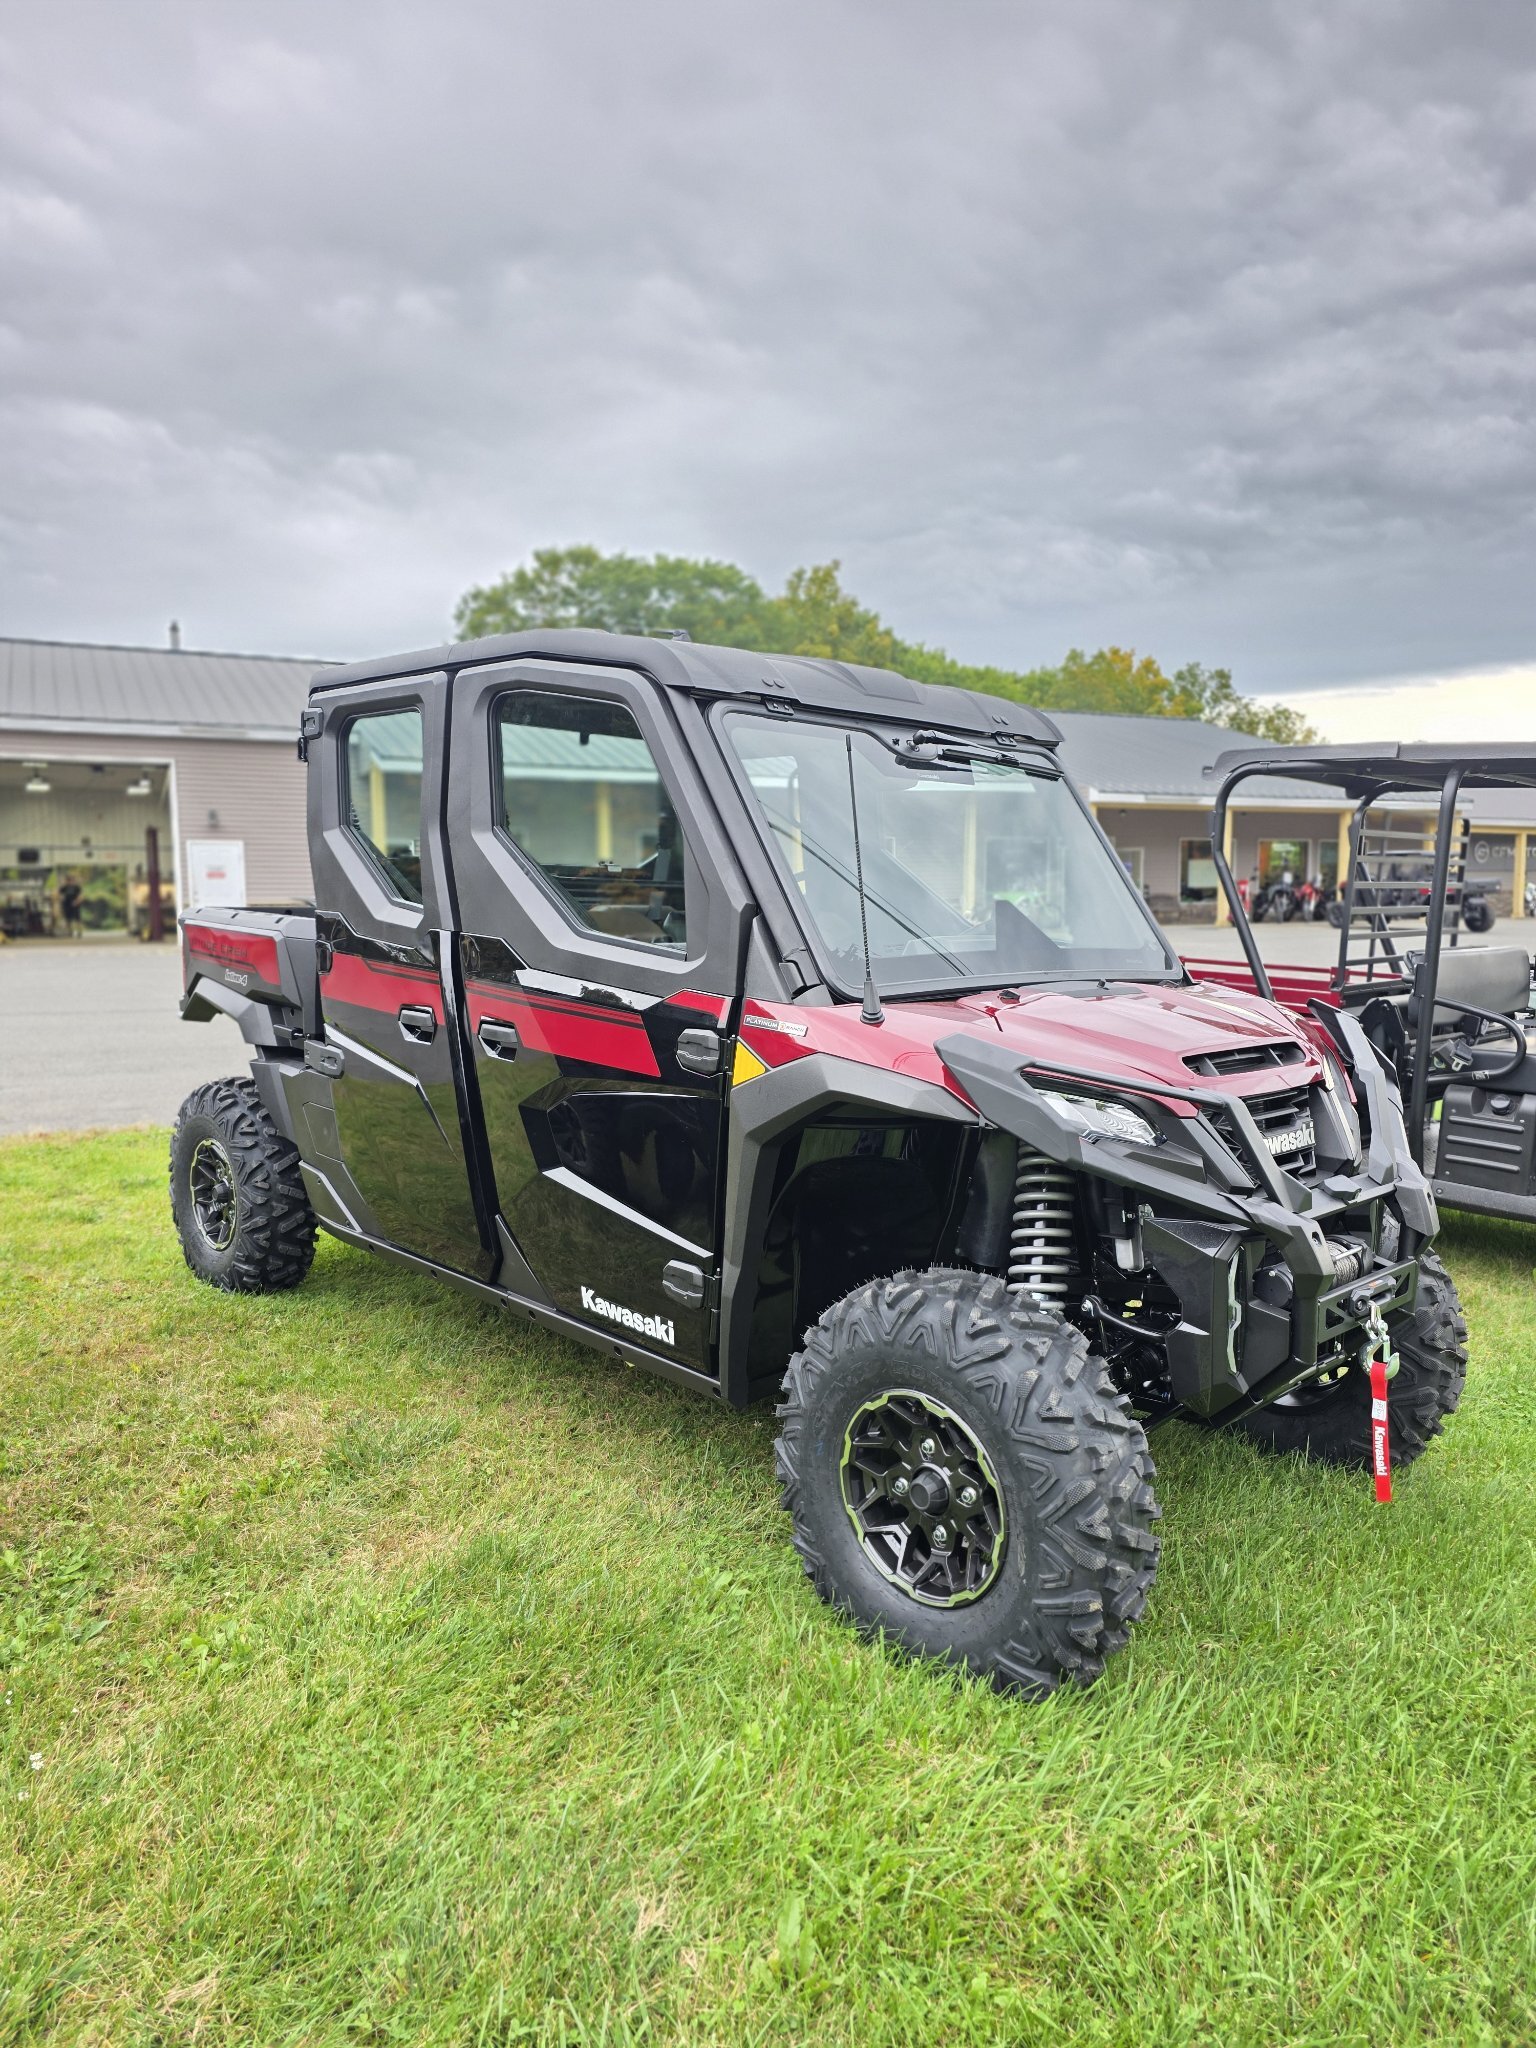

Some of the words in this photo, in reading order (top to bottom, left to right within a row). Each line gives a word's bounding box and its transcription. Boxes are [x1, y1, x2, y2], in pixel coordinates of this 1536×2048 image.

[1491, 846, 1536, 858] CFMTO
[746, 1017, 778, 1029] PLATINUM
[1263, 1121, 1316, 1154] wasaki
[580, 1285, 675, 1346] Kawasaki
[1374, 1425, 1388, 1476] Kawasaki
